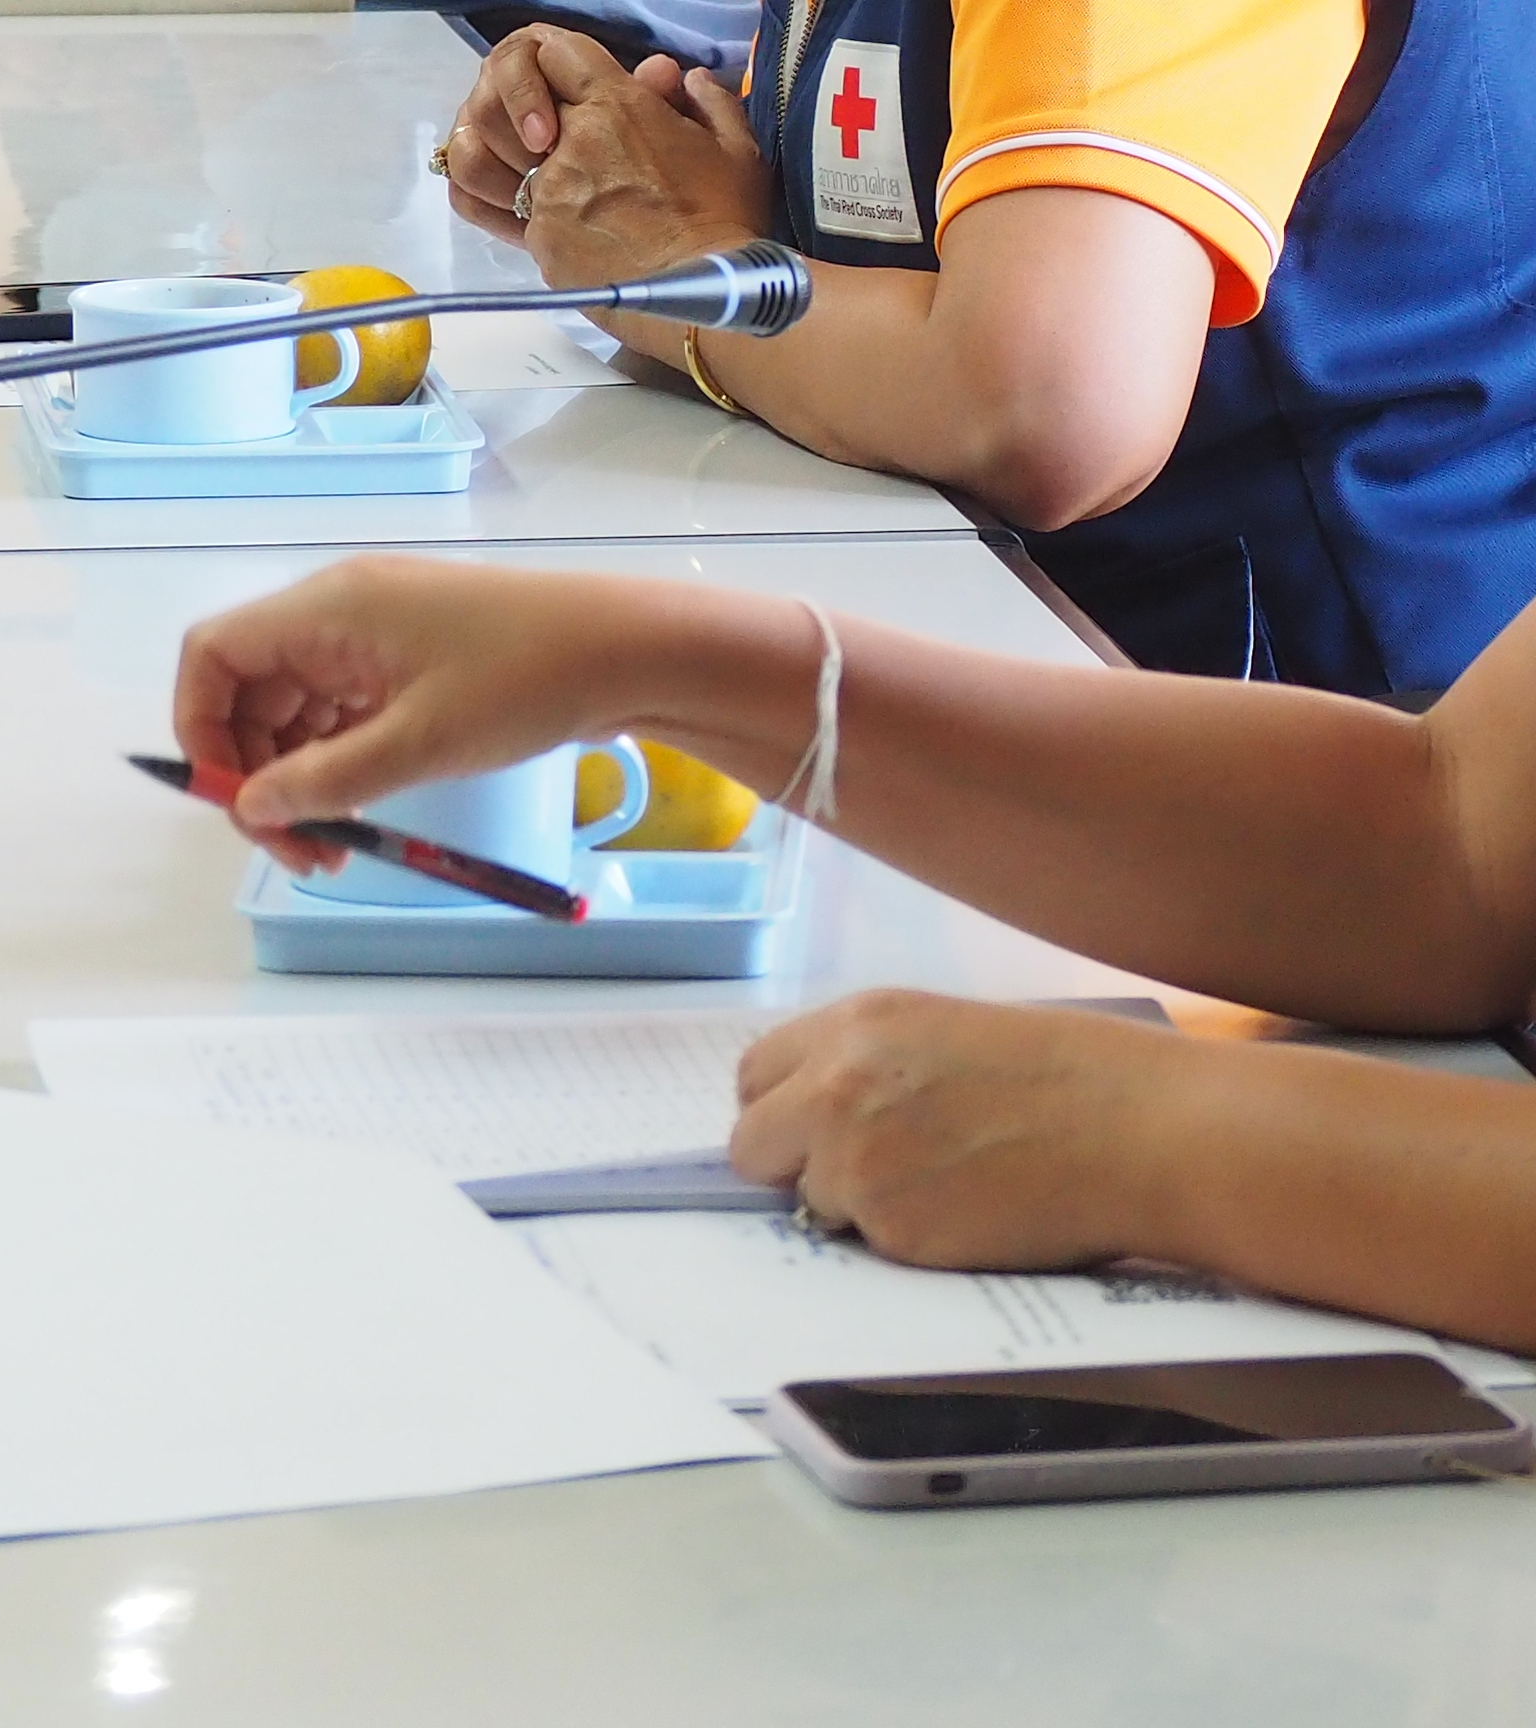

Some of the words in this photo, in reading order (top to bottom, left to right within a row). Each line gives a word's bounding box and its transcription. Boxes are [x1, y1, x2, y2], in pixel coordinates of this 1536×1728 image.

[819, 167, 901, 198] สภากาชาดไทย
[841, 199, 855, 216] Red
[855, 201, 876, 219] Cross
[875, 204, 903, 223] Society
